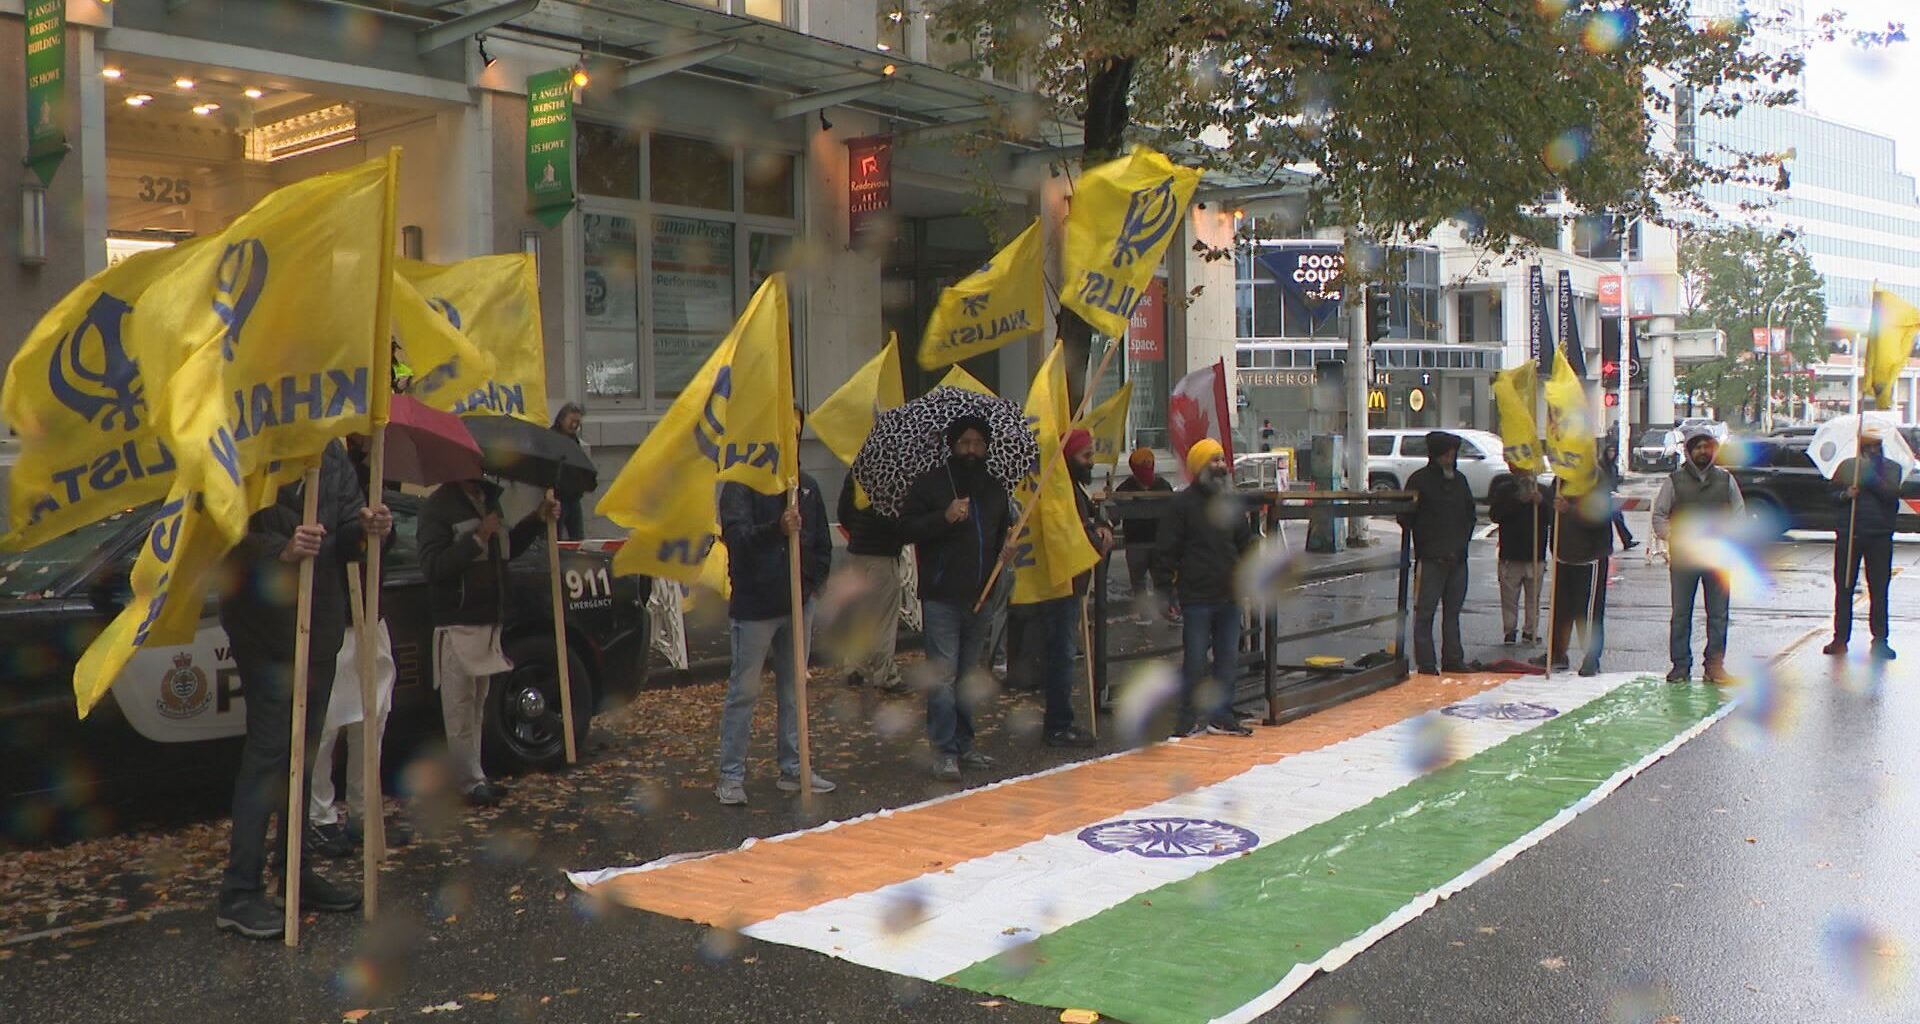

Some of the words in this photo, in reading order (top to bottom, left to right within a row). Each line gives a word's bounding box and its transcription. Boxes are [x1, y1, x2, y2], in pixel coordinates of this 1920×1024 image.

[30, 17, 59, 36] WEBSTER
[28, 35, 60, 55] BUILDING
[533, 99, 566, 113] WEBSTER
[530, 112, 567, 128] BUILDING
[541, 140, 564, 152] HOWE
[138, 175, 192, 205] 325
[862, 192, 878, 202] ART
[851, 201, 889, 213] GALLERY
[1532, 270, 1541, 306] CENTRE
[1560, 274, 1569, 308] CENTRE
[1131, 312, 1148, 328] this
[1131, 337, 1158, 355] space.
[1236, 373, 1318, 386] ATERFRON
[565, 567, 611, 599] 911
[569, 599, 612, 610] EMERGENCY
